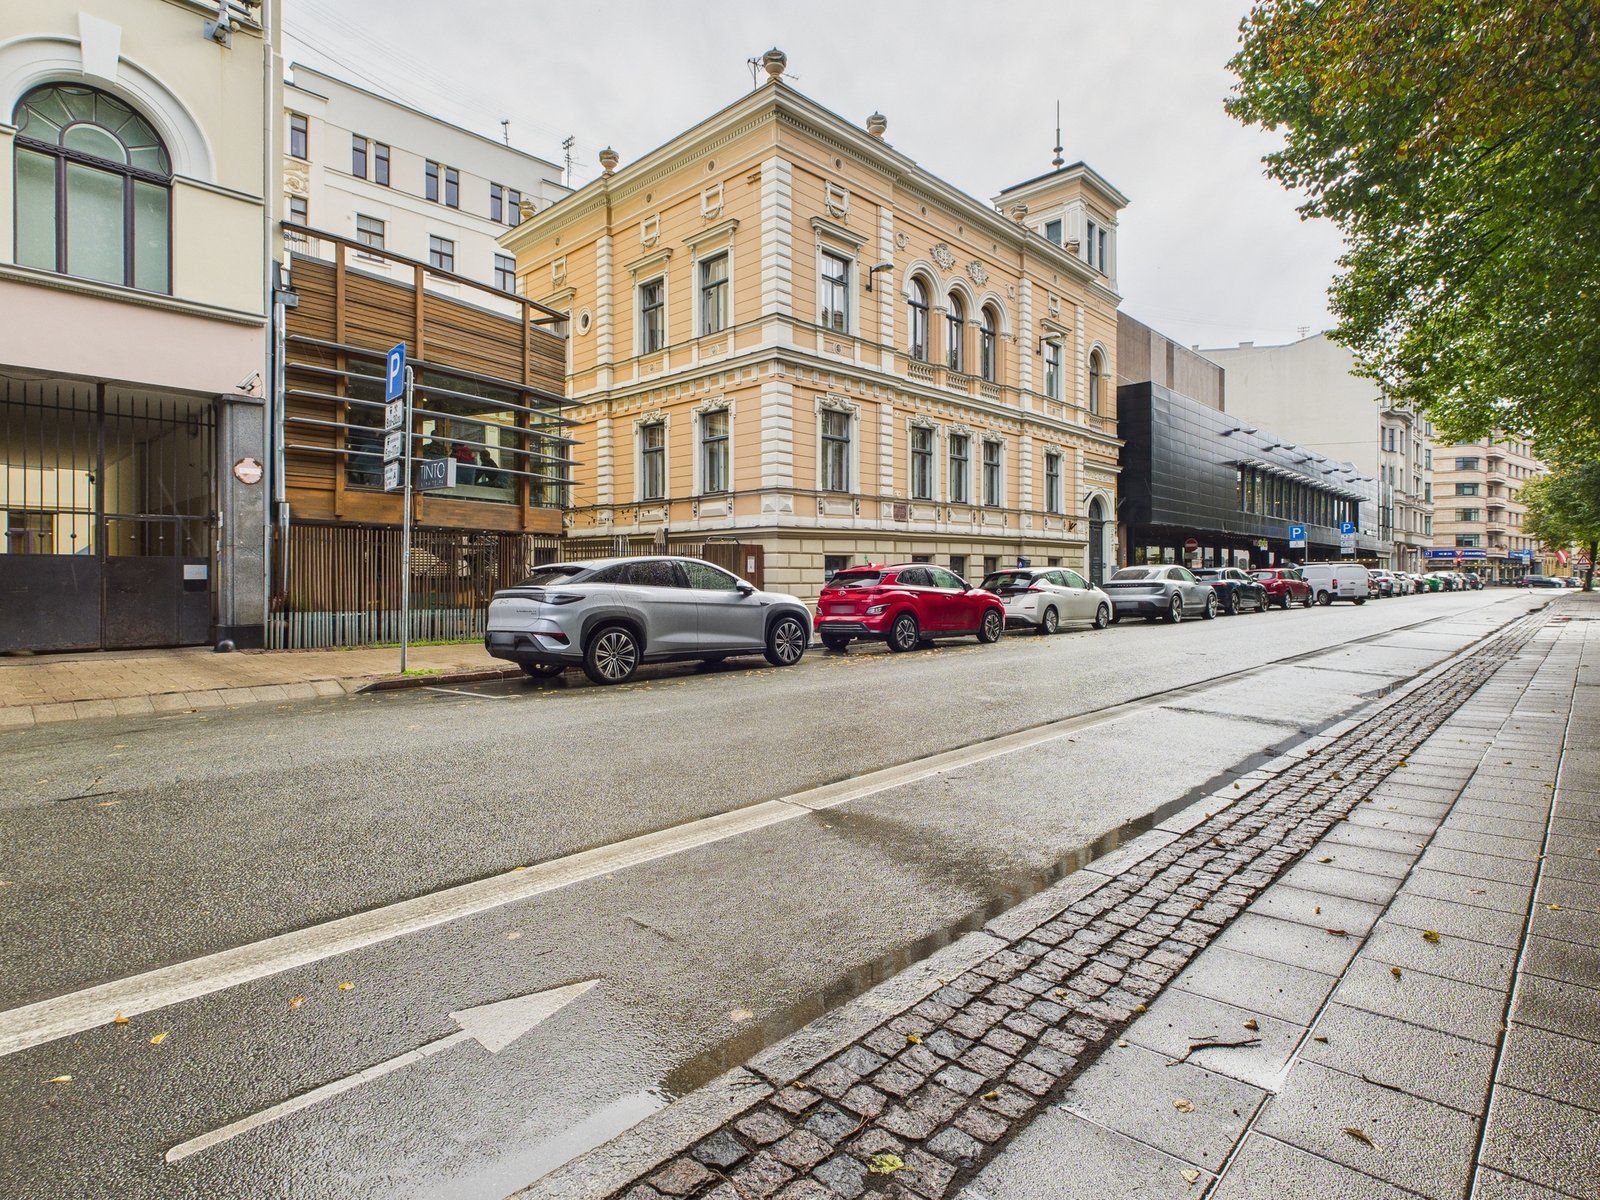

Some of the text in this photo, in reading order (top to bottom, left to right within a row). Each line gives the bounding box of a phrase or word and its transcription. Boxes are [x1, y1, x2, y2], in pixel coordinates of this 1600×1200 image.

[389, 352, 400, 393] P
[420, 462, 446, 480] TINTO
[1292, 527, 1302, 539] P
[1343, 523, 1351, 533] P
